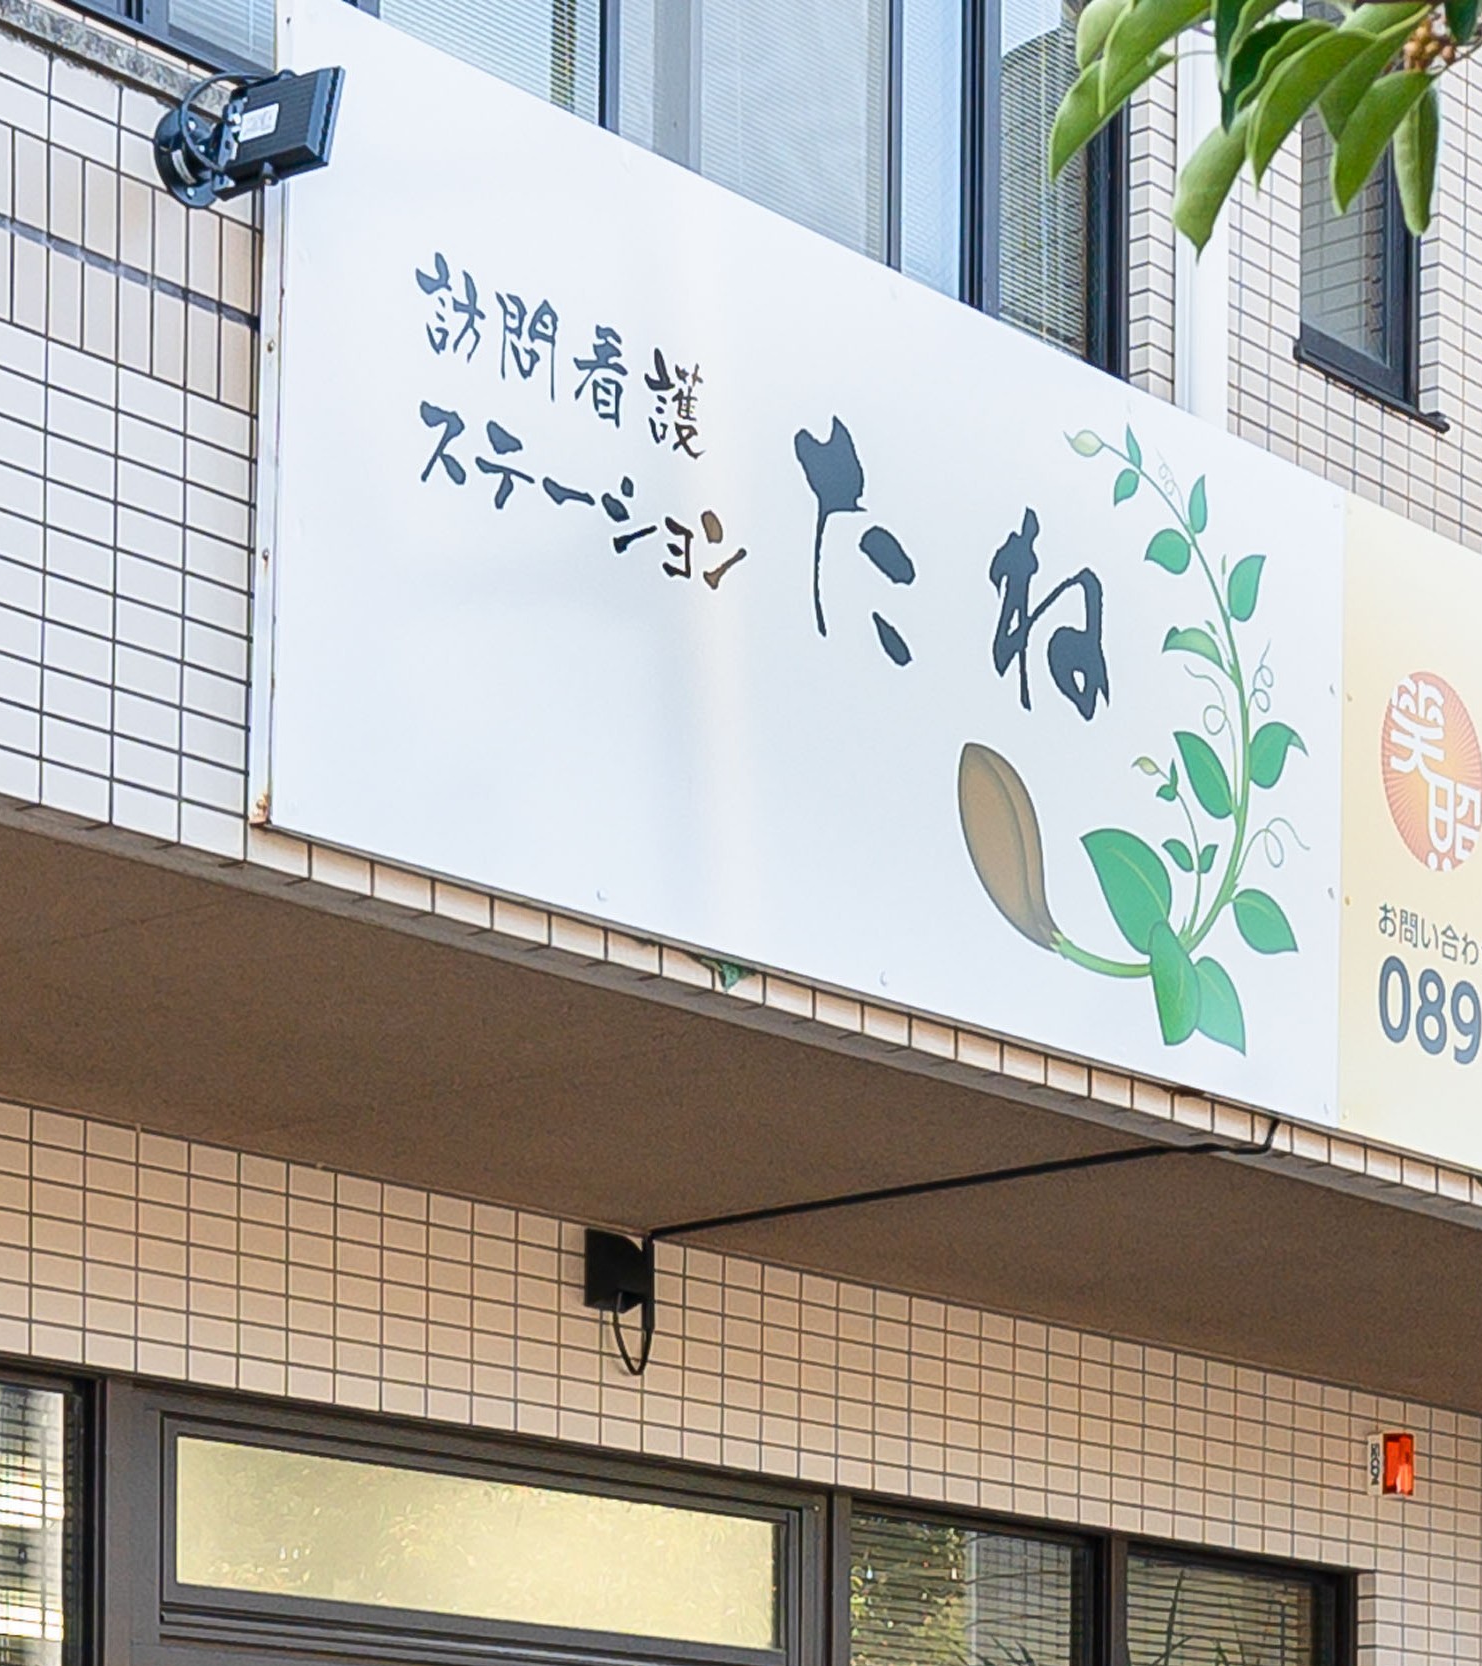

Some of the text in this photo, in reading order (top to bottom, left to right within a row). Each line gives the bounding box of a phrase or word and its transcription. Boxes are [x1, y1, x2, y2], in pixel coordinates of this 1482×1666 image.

[416, 252, 706, 458] 訪問看護
[420, 402, 747, 589] ステーション
[795, 415, 1110, 721] たね
